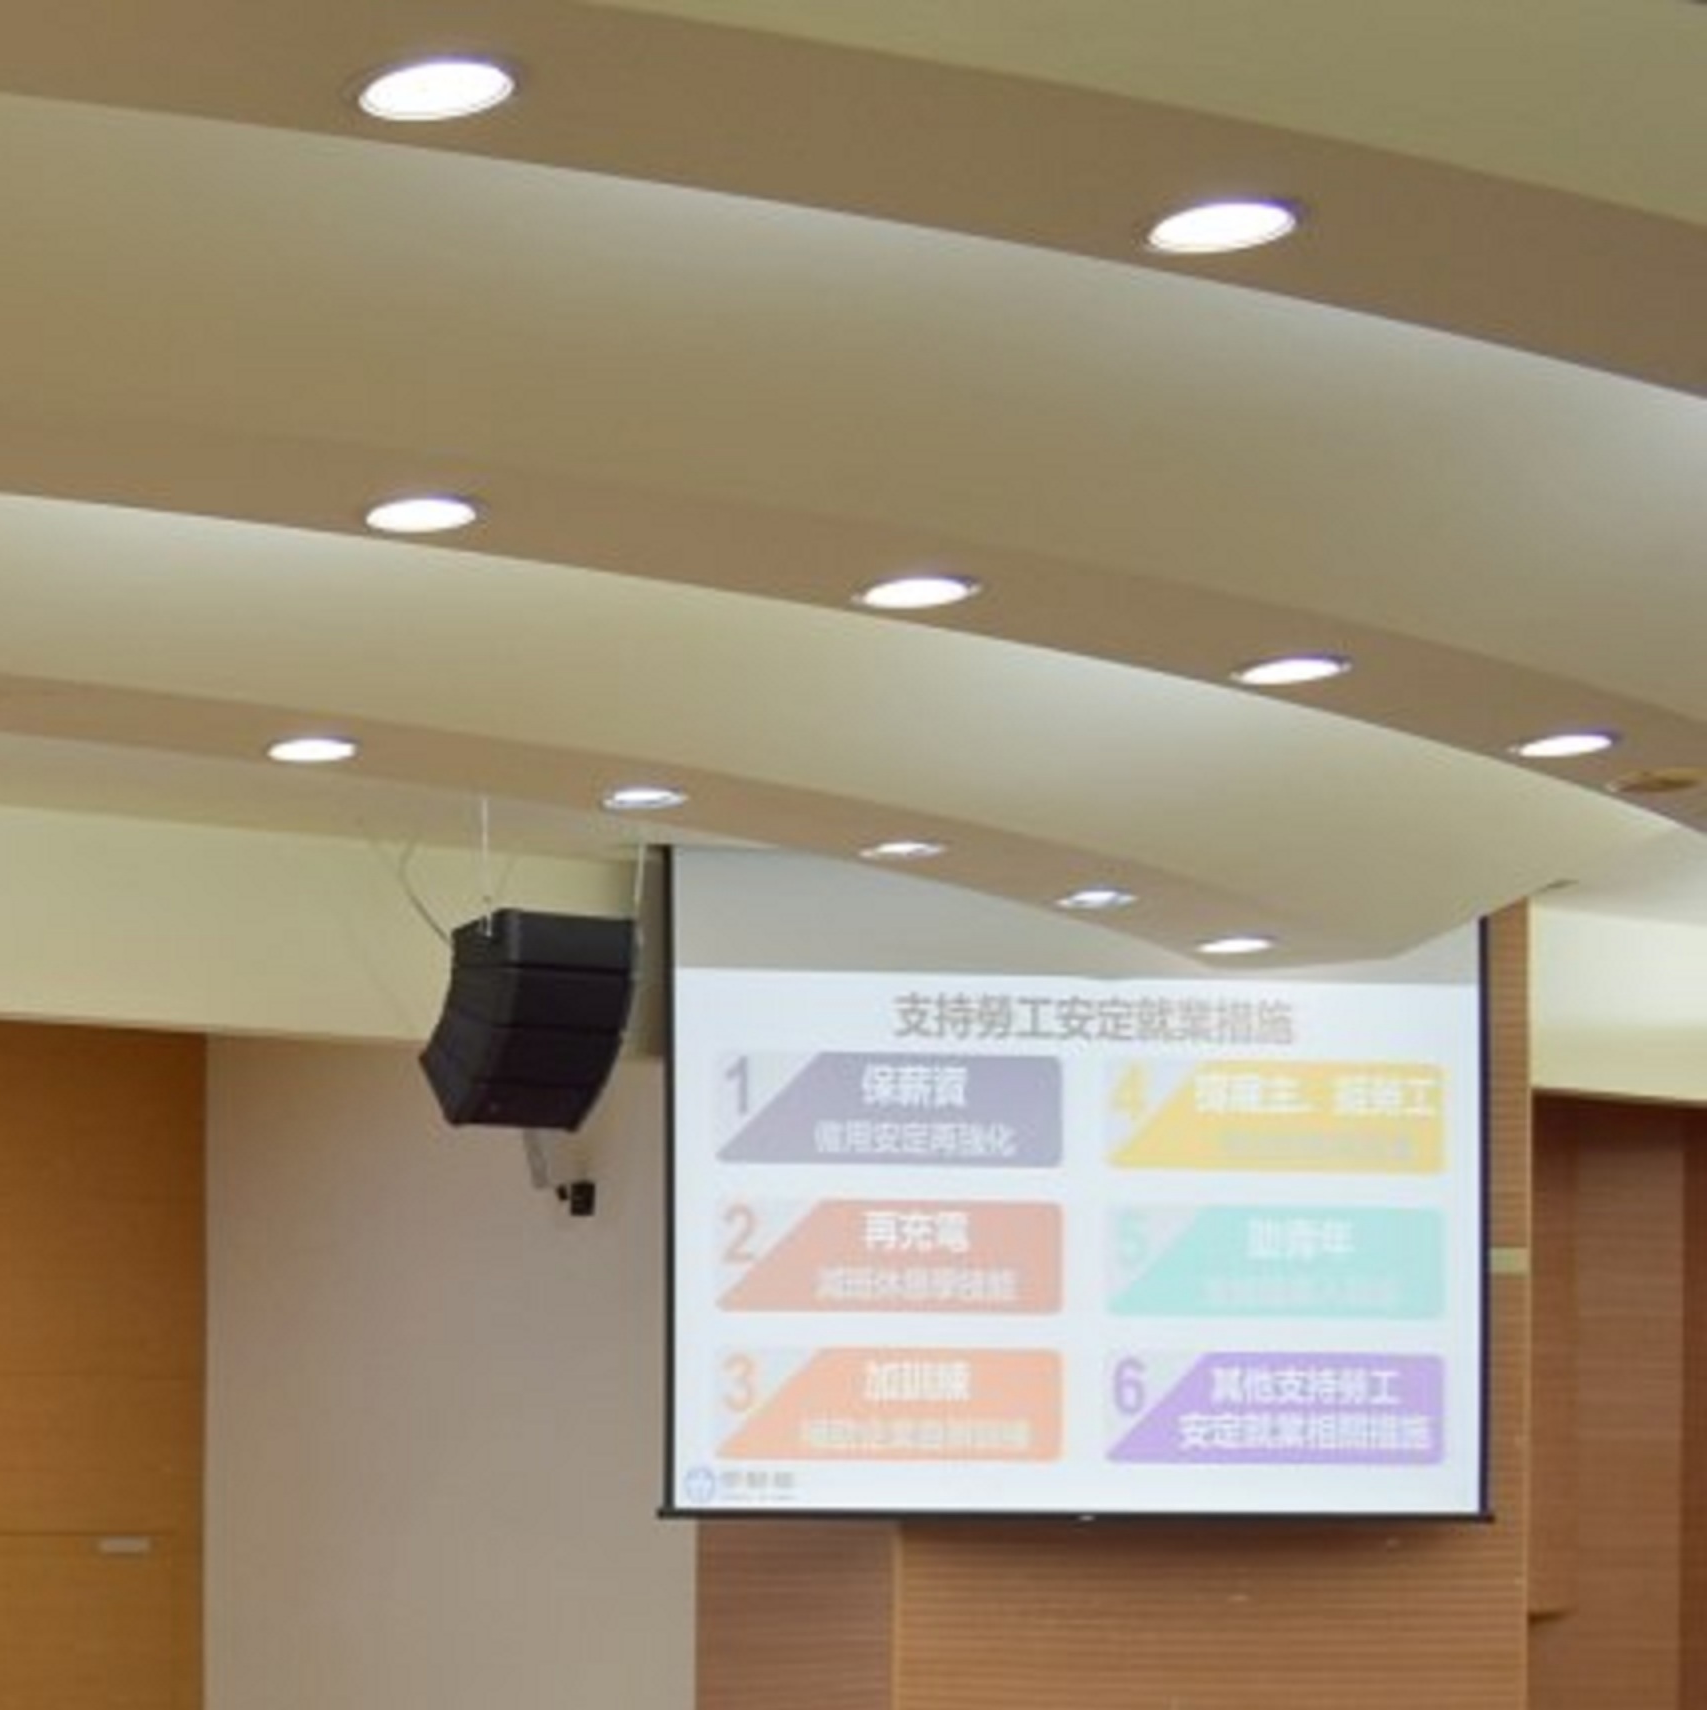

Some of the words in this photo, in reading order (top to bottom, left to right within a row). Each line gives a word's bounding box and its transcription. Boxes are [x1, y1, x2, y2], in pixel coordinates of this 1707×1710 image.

[894, 991, 1295, 1045] 支持勞工安定就業措施
[725, 1055, 749, 1115] 1
[862, 1063, 968, 1107] 保薪資
[1109, 1062, 1148, 1119] 4
[721, 1204, 756, 1264] 2
[861, 1211, 970, 1252] 再充電
[723, 1353, 755, 1412] 3
[1114, 1358, 1146, 1416] 6
[1211, 1366, 1401, 1405] 其他支持勞工
